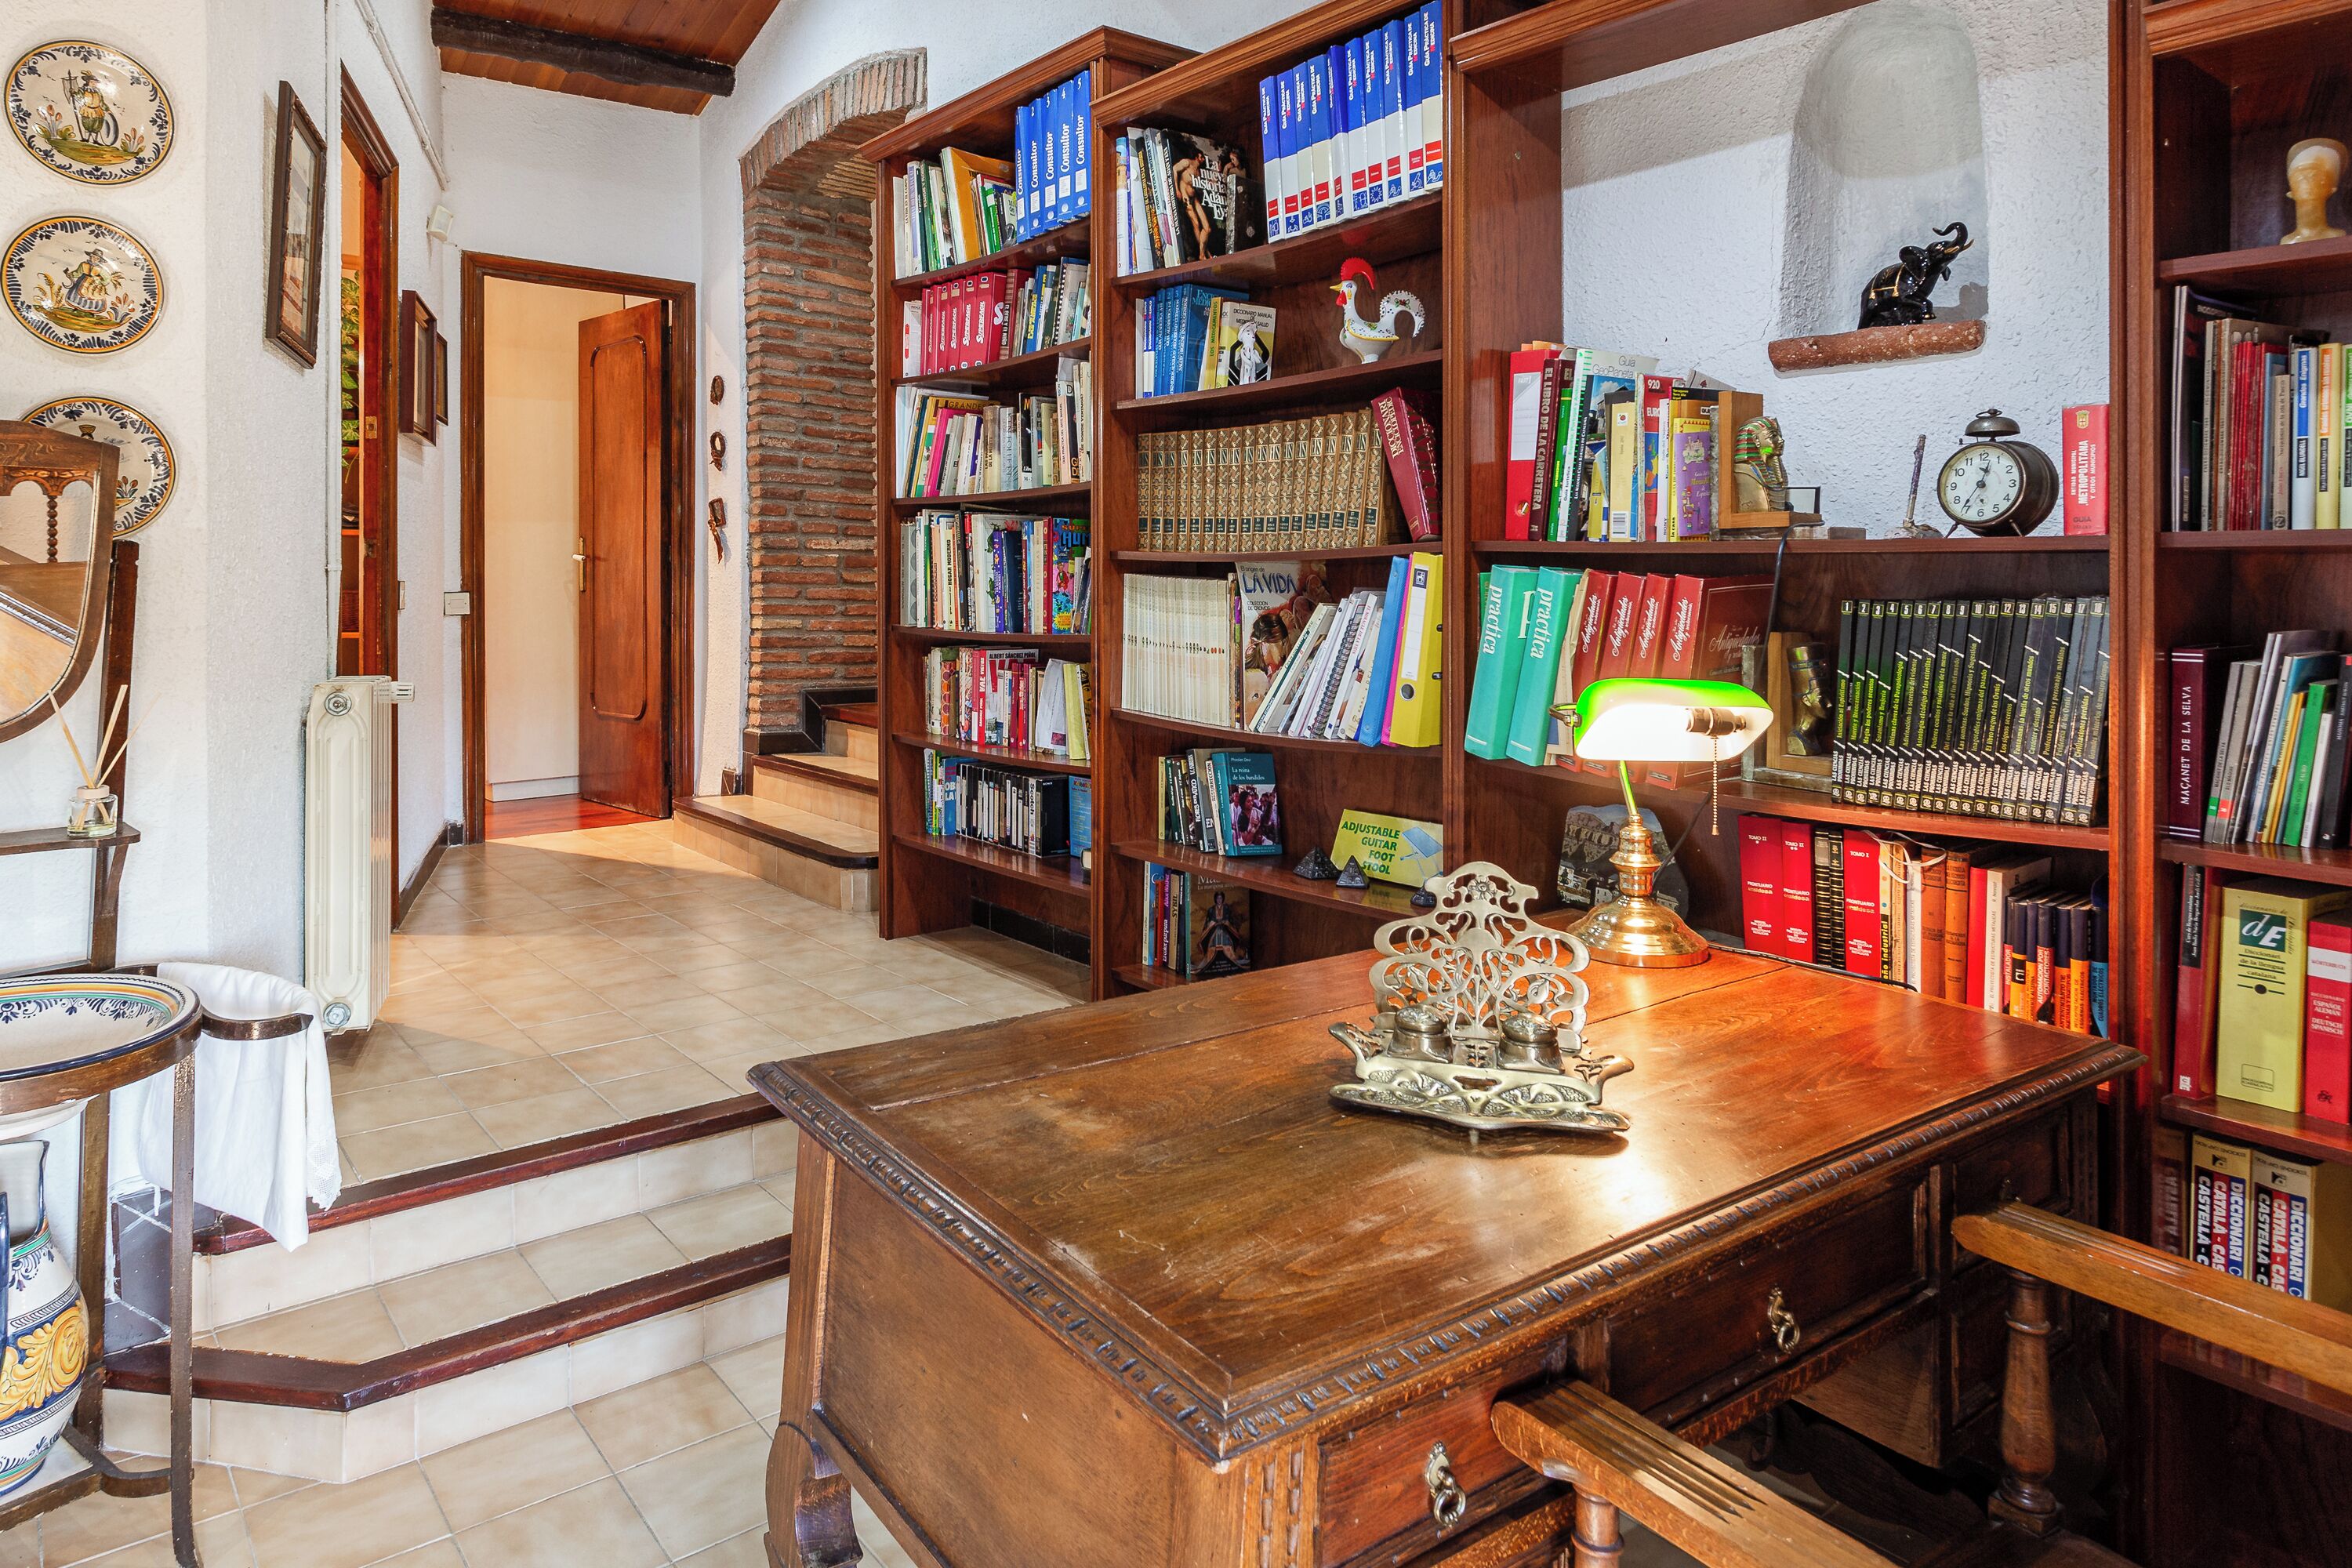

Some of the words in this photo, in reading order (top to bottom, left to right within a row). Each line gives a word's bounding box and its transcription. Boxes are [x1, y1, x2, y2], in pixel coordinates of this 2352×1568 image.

[1424, 11, 1428, 21] DE
[1077, 78, 1081, 89] 5
[1062, 88, 1066, 99] 4
[1046, 93, 1050, 108] 3
[1031, 107, 1034, 117] 2
[1061, 124, 1069, 172] Consultor
[1204, 154, 1219, 171] La
[1192, 174, 1227, 193] historia
[1619, 356, 1636, 367] Guía
[1544, 368, 1553, 380] EL
[1593, 364, 1634, 378] GeoPlaneta
[1648, 379, 1660, 390] 920
[1541, 382, 1552, 414] LIBRO
[1540, 416, 1549, 430] DE
[1378, 399, 1399, 459] DICCIONARI
[1538, 433, 1548, 446] LA
[1979, 452, 1989, 461] 12
[2006, 465, 2013, 474] 2
[2078, 440, 2089, 505] METROPOLITANA
[1532, 448, 1546, 510] CARRETERA
[2009, 479, 2016, 488] 3
[1954, 495, 1961, 504] 8
[2003, 493, 2011, 502] 4
[1963, 505, 1970, 514] 7
[1993, 504, 1999, 513] 5
[1242, 572, 1264, 593] LA
[1262, 572, 1299, 593] VIDA
[1846, 602, 1849, 612] 1
[1862, 604, 1866, 612] 2
[1876, 605, 1880, 615] 3
[1890, 603, 1894, 612] 4
[1904, 605, 1908, 615] 5
[1918, 605, 1922, 615] 6
[1931, 605, 1936, 615] 7
[1946, 604, 1951, 614] 8
[1960, 605, 1965, 615] 9
[1975, 604, 1982, 614] 10
[1989, 605, 1995, 615] 11
[2004, 604, 2012, 613] 12
[2034, 605, 2042, 615] 14
[2049, 603, 2056, 613] 15
[2064, 603, 2072, 613] 16
[1583, 593, 1598, 653] Antigüedades
[1610, 595, 1628, 657] Antigüedades
[1639, 596, 1655, 659] Antigüedades
[1668, 597, 1688, 662] Antigüedades
[2182, 685, 2191, 715] SELVA
[2182, 721, 2191, 732] LA
[2182, 739, 2190, 752] DE
[2180, 756, 2191, 805] MAÇANET
[1341, 821, 1399, 839] ADJUSTABLE
[1362, 837, 1397, 851] GUITAR
[1369, 850, 1396, 862] FOOT
[1362, 862, 1391, 874] STOOL
[1846, 898, 1875, 907] PRONTUARIO
[2310, 1023, 2345, 1035] SPANISCH
[2311, 1018, 2343, 1029] DEUTSCH
[2197, 1176, 2211, 1245] CASTELLÀ
[2213, 1180, 2227, 1235] CATALÀ
[2229, 1181, 2244, 1261] DICCIONARI
[2272, 1199, 2287, 1254] CATALÀ
[2256, 1193, 2270, 1264] CASTELLÀ
[2288, 1201, 2304, 1283] DICCIONARI
